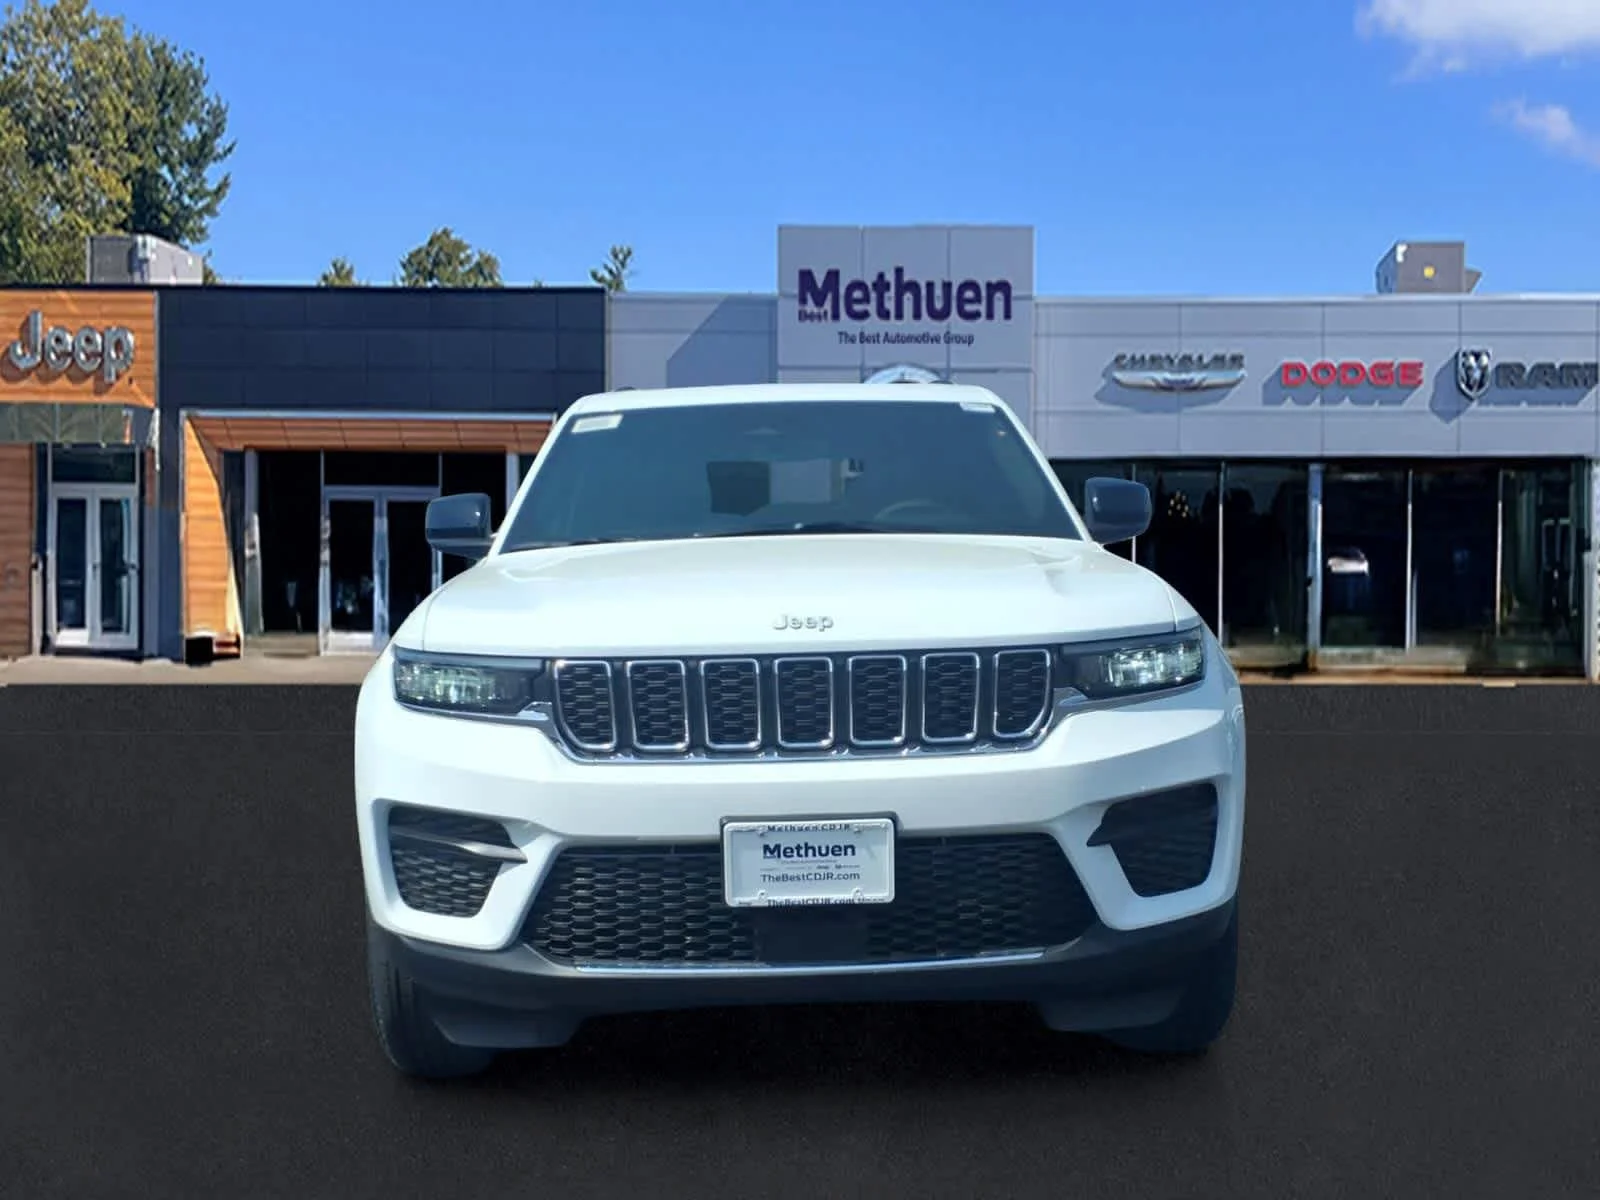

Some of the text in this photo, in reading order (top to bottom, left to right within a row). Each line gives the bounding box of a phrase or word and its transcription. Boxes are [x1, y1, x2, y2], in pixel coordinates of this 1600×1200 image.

[798, 266, 1012, 321] Methuen
[798, 309, 828, 322] Best
[9, 310, 135, 383] Jeep
[837, 331, 975, 346] The Best Automotive Group
[1114, 353, 1245, 369] CHRYSLER
[1281, 361, 1424, 387] DODGE
[1494, 361, 1599, 389] RAM
[772, 613, 835, 632] Jeep
[763, 842, 856, 859] Methuen
[760, 871, 861, 883] TheBestCDJR.com
